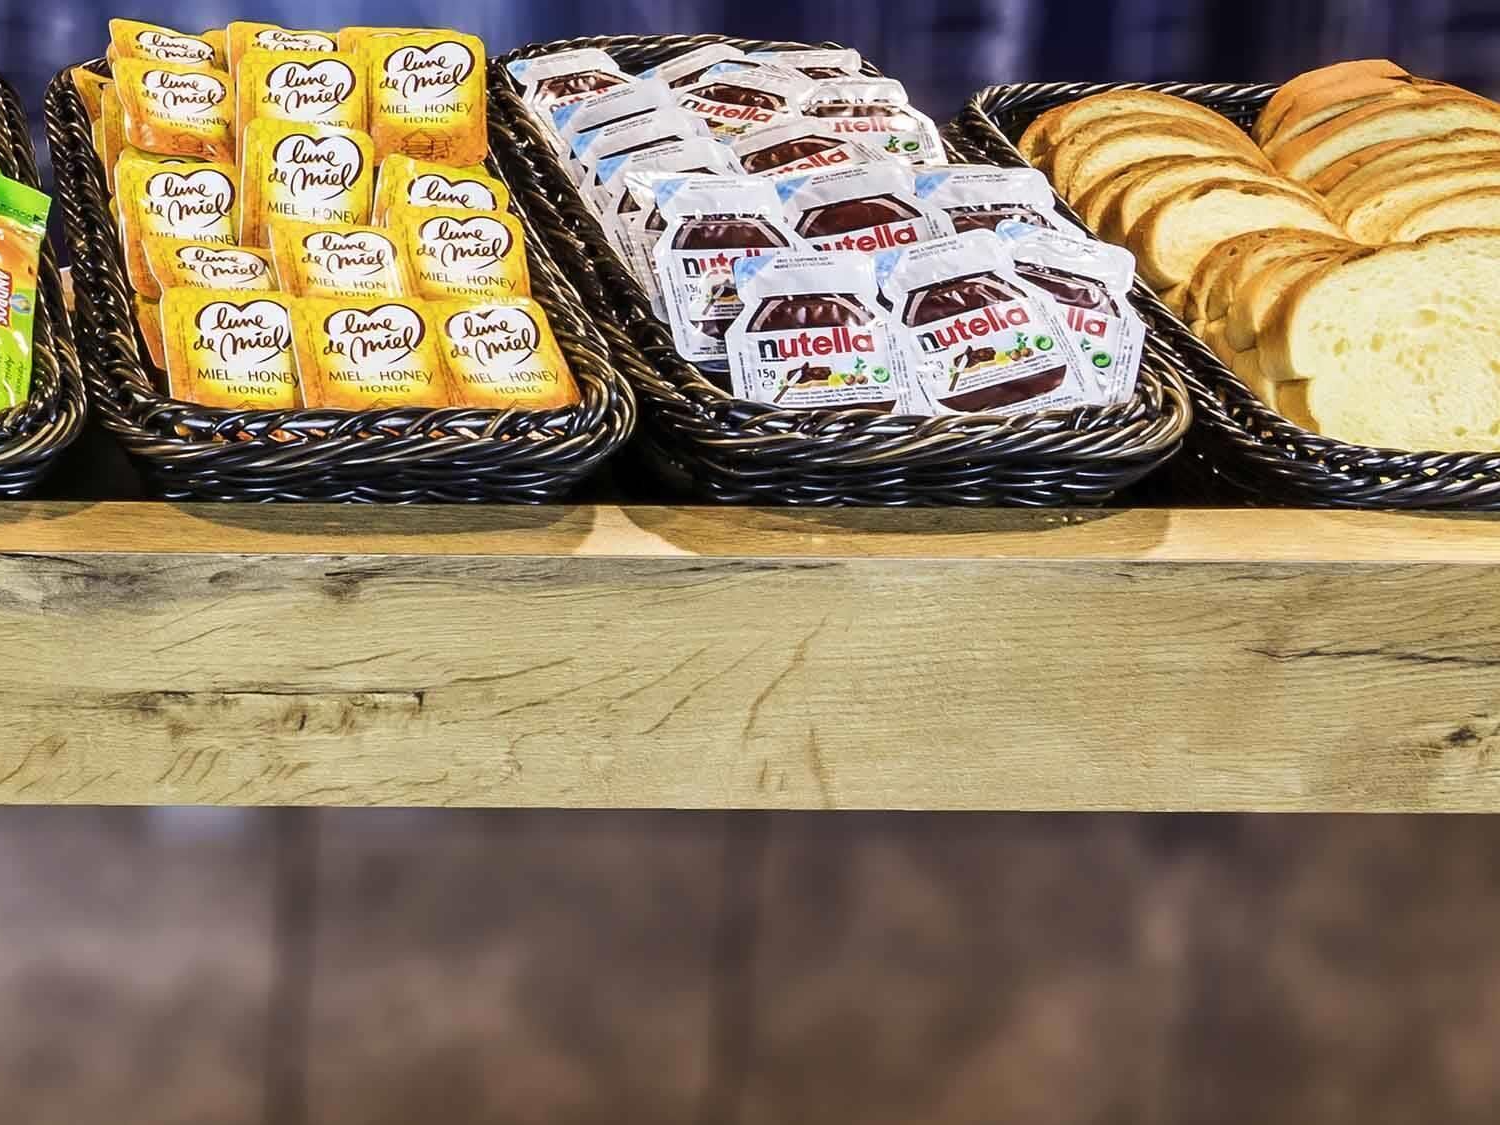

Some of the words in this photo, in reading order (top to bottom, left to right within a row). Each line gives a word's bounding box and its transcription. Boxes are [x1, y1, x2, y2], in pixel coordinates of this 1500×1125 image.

[402, 50, 451, 72] lune
[379, 75, 399, 90] de
[402, 69, 464, 98] miel
[379, 103, 408, 113] MIEL
[425, 102, 474, 114] HONEY
[682, 100, 773, 123] nutella
[404, 116, 450, 124] HONIG
[216, 307, 267, 331] lune
[341, 314, 392, 335] lune
[464, 315, 516, 336] lune
[917, 304, 1030, 353] nutella
[194, 335, 215, 352] de
[221, 333, 289, 362] miel
[323, 340, 345, 356] de
[350, 337, 420, 364] miel
[450, 344, 469, 359] de
[475, 339, 535, 365] miel
[759, 327, 874, 361] nutella
[198, 368, 232, 381] MIEL
[248, 370, 300, 385] HONEY
[329, 371, 364, 383] MIEL
[379, 370, 433, 385] HONEY
[462, 372, 494, 385] MIEL
[509, 371, 559, 386] HONEY
[757, 367, 777, 380] 15g
[227, 385, 277, 396] HONIG
[359, 384, 410, 395] HONIG
[494, 384, 542, 395] HONIG
